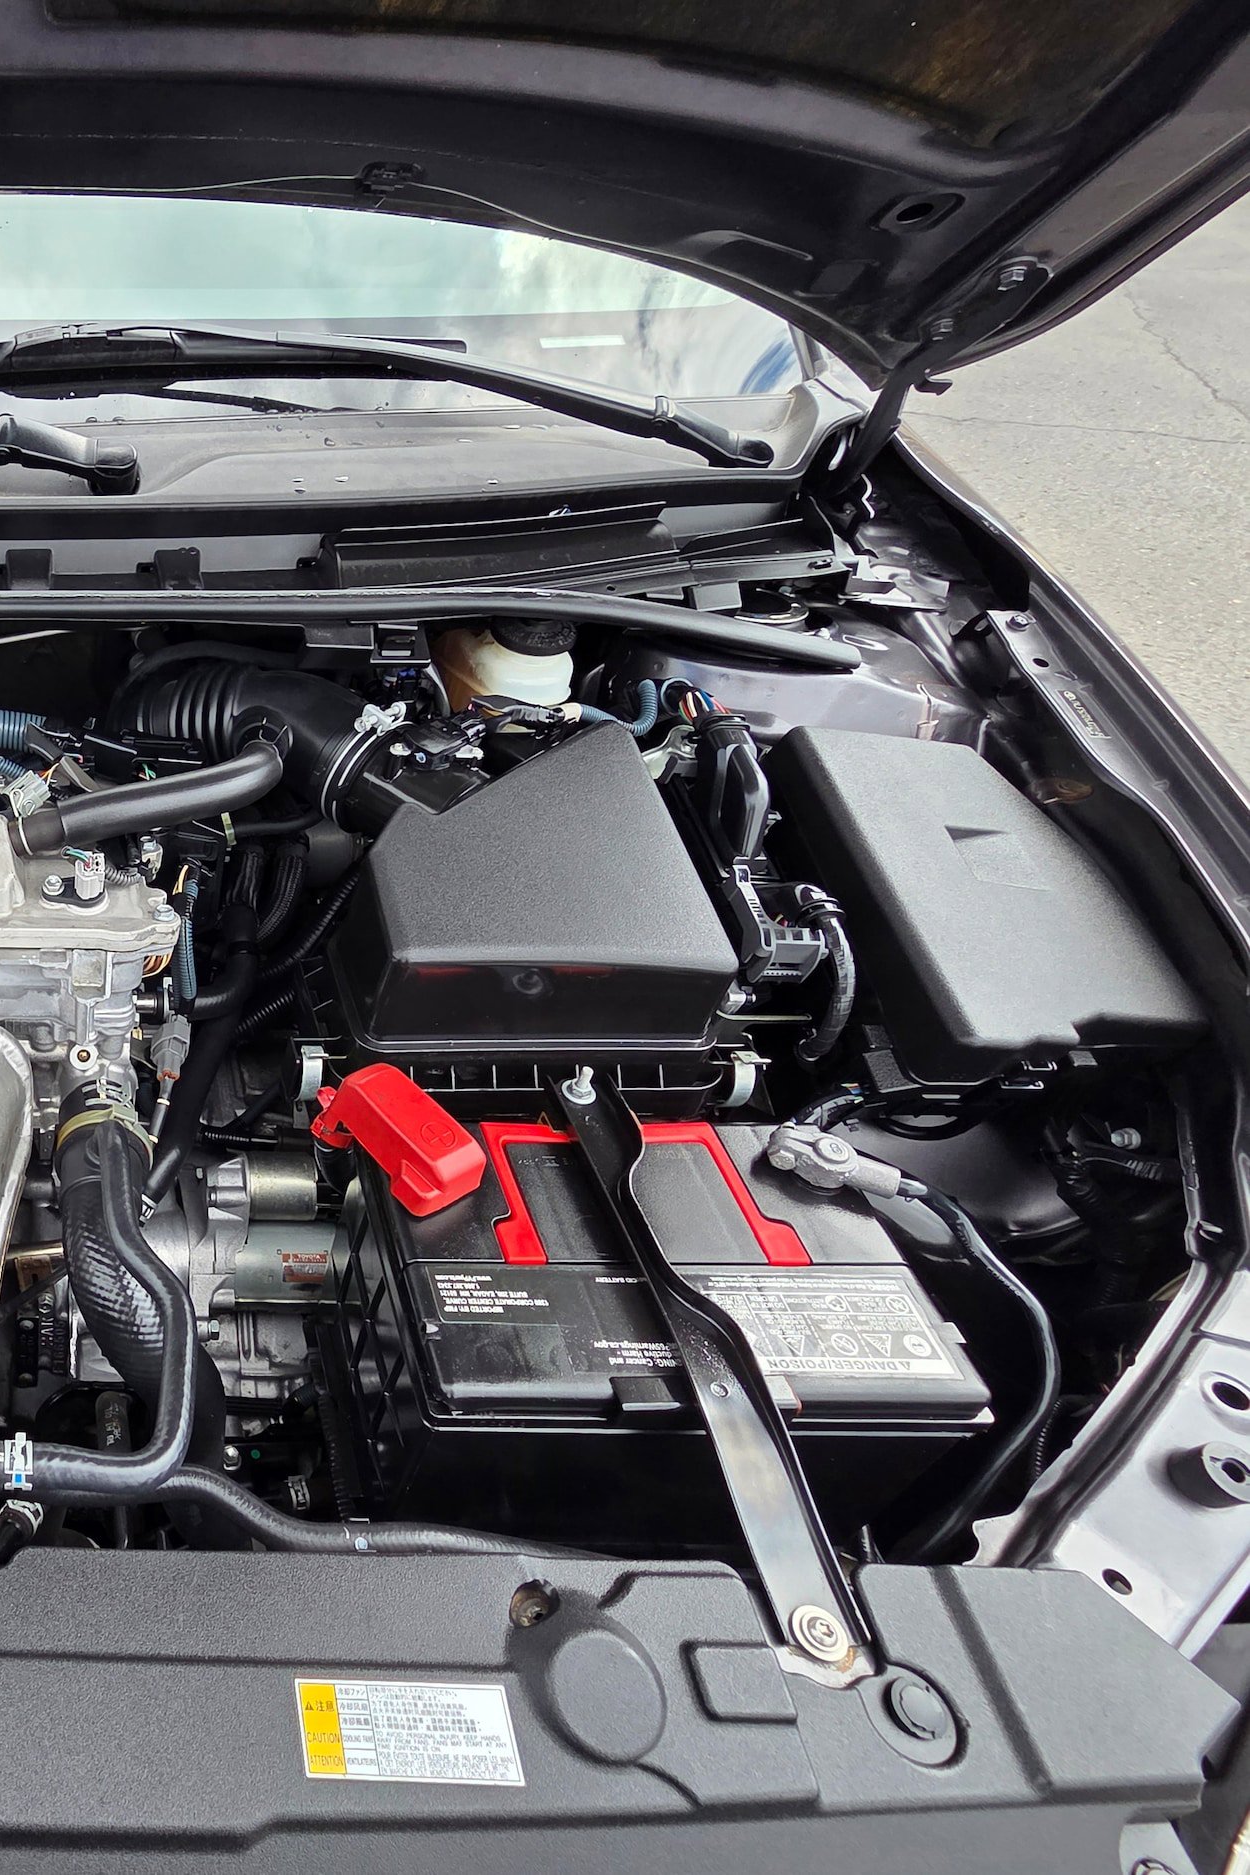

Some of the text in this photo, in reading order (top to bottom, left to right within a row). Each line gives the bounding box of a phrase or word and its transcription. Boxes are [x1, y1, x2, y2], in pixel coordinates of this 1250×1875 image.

[609, 1357, 624, 1365] and
[625, 1358, 653, 1366] Cancer
[766, 1358, 898, 1371] DANGER/POISON
[316, 1700, 335, 1712] 注意
[307, 1731, 340, 1744] CAUTION
[310, 1755, 344, 1767] ATTENTION
